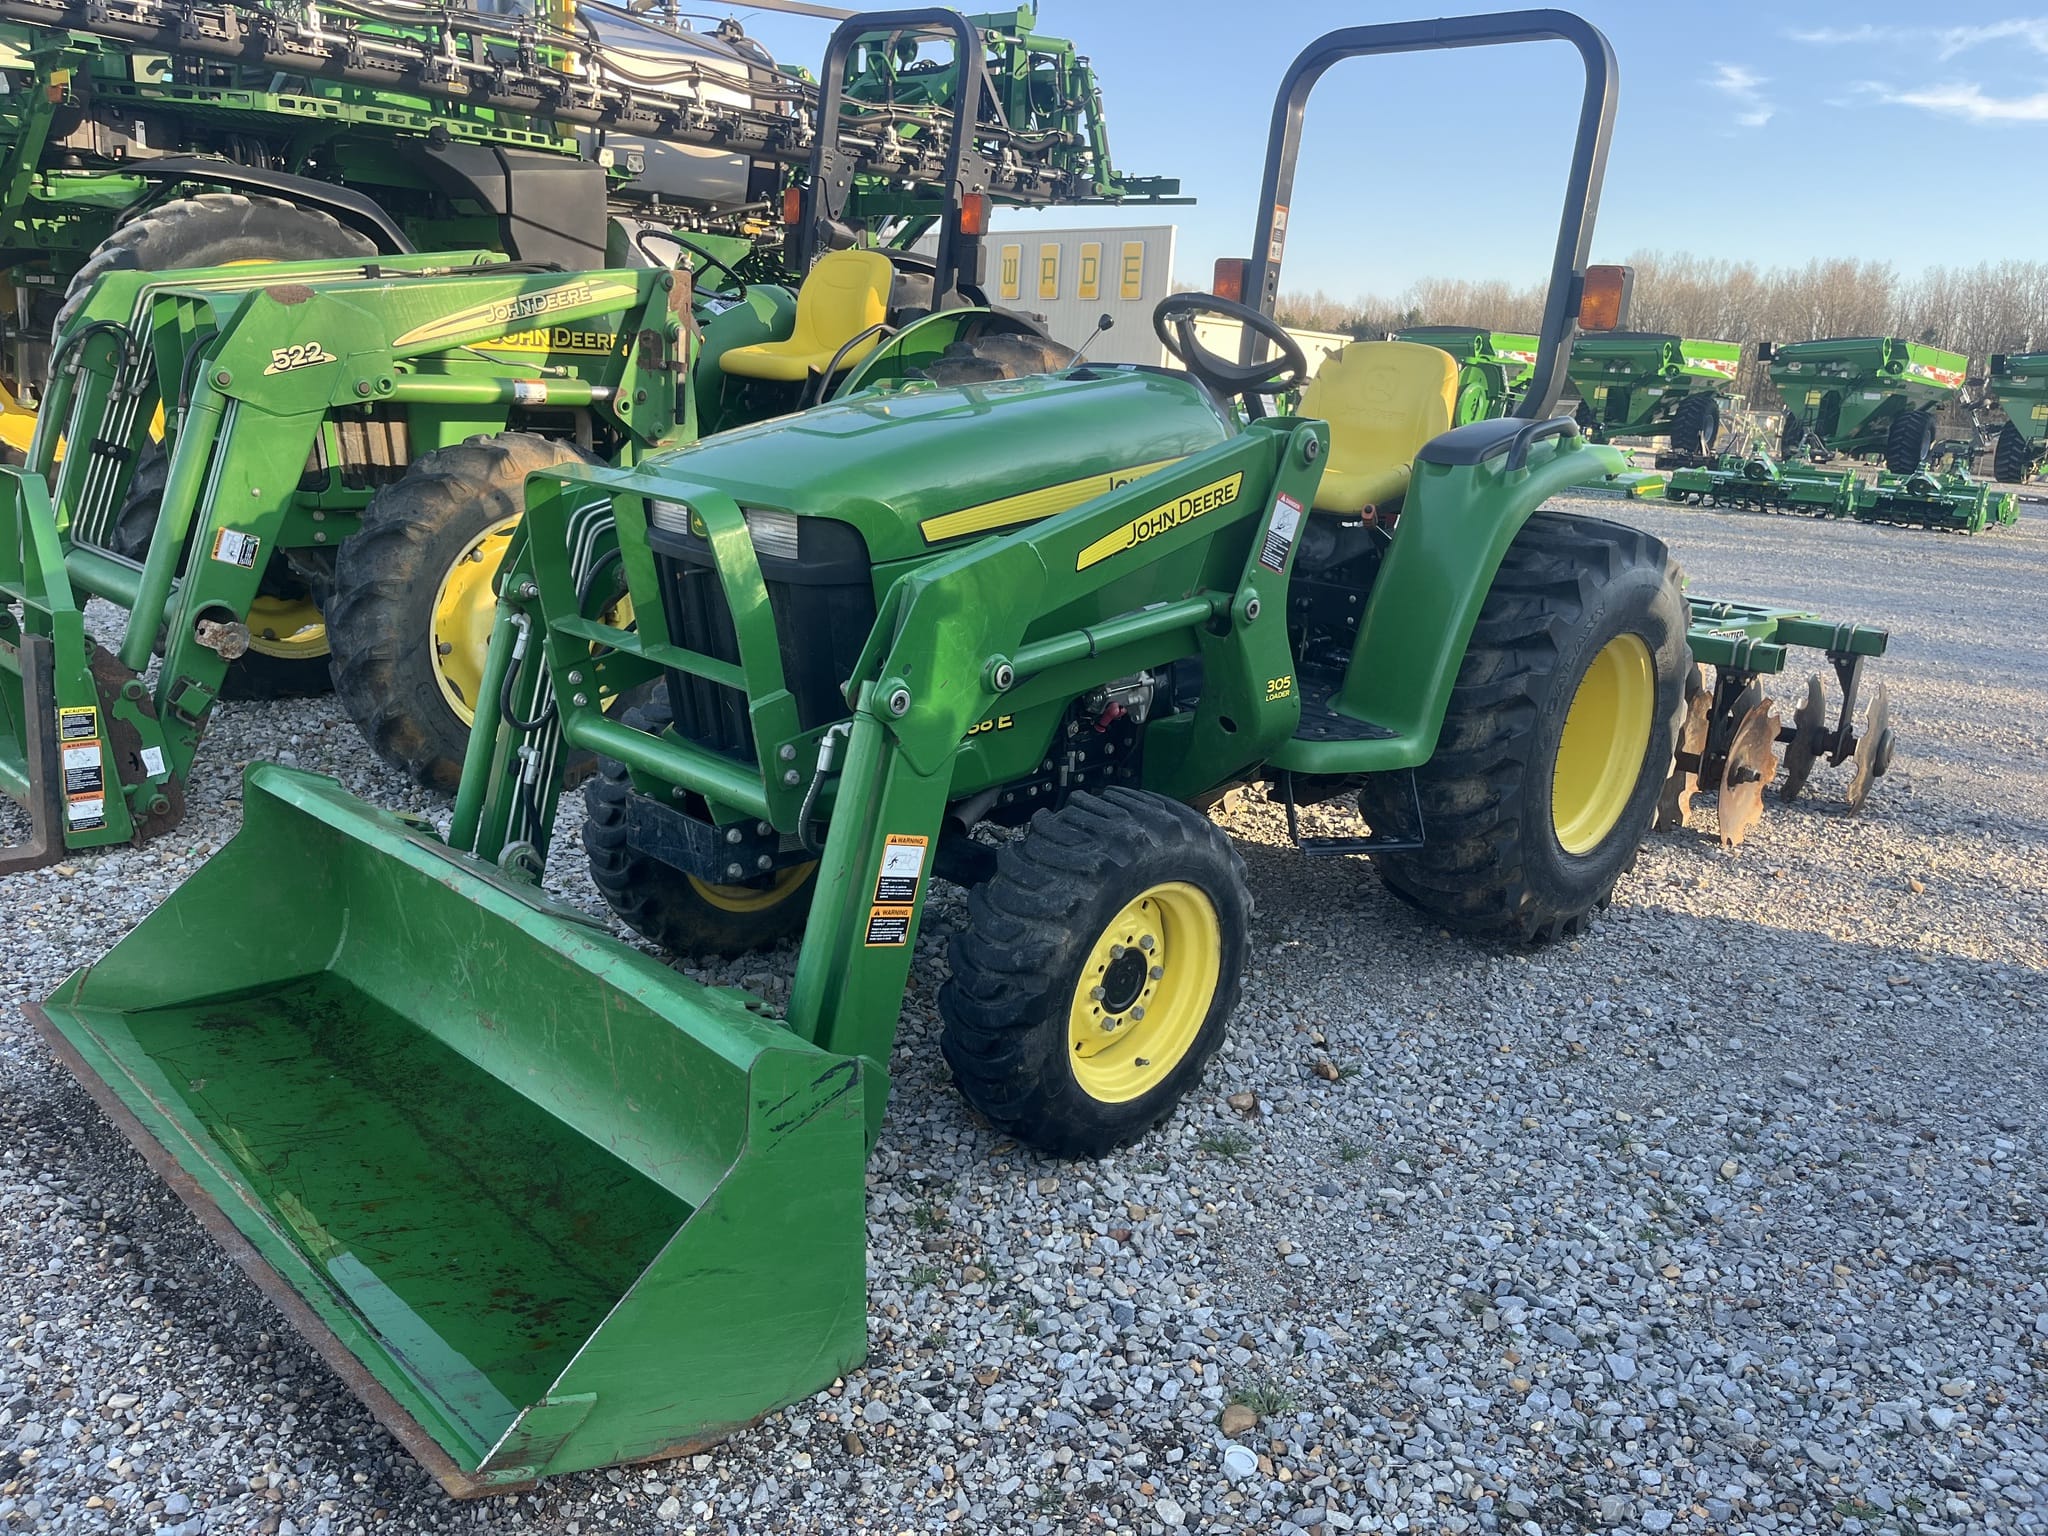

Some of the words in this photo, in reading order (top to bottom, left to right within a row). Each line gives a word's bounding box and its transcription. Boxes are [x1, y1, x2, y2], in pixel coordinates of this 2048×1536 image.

[1003, 256, 1140, 285] WADE
[485, 296, 533, 323] JOHN
[533, 286, 592, 312] DEERE
[272, 341, 324, 370] 522
[1127, 508, 1175, 546] JOHN
[1179, 483, 1234, 520] DEERE
[1265, 690, 1290, 702] LOADER
[1266, 675, 1291, 693] 305
[897, 836, 924, 845] WARNING
